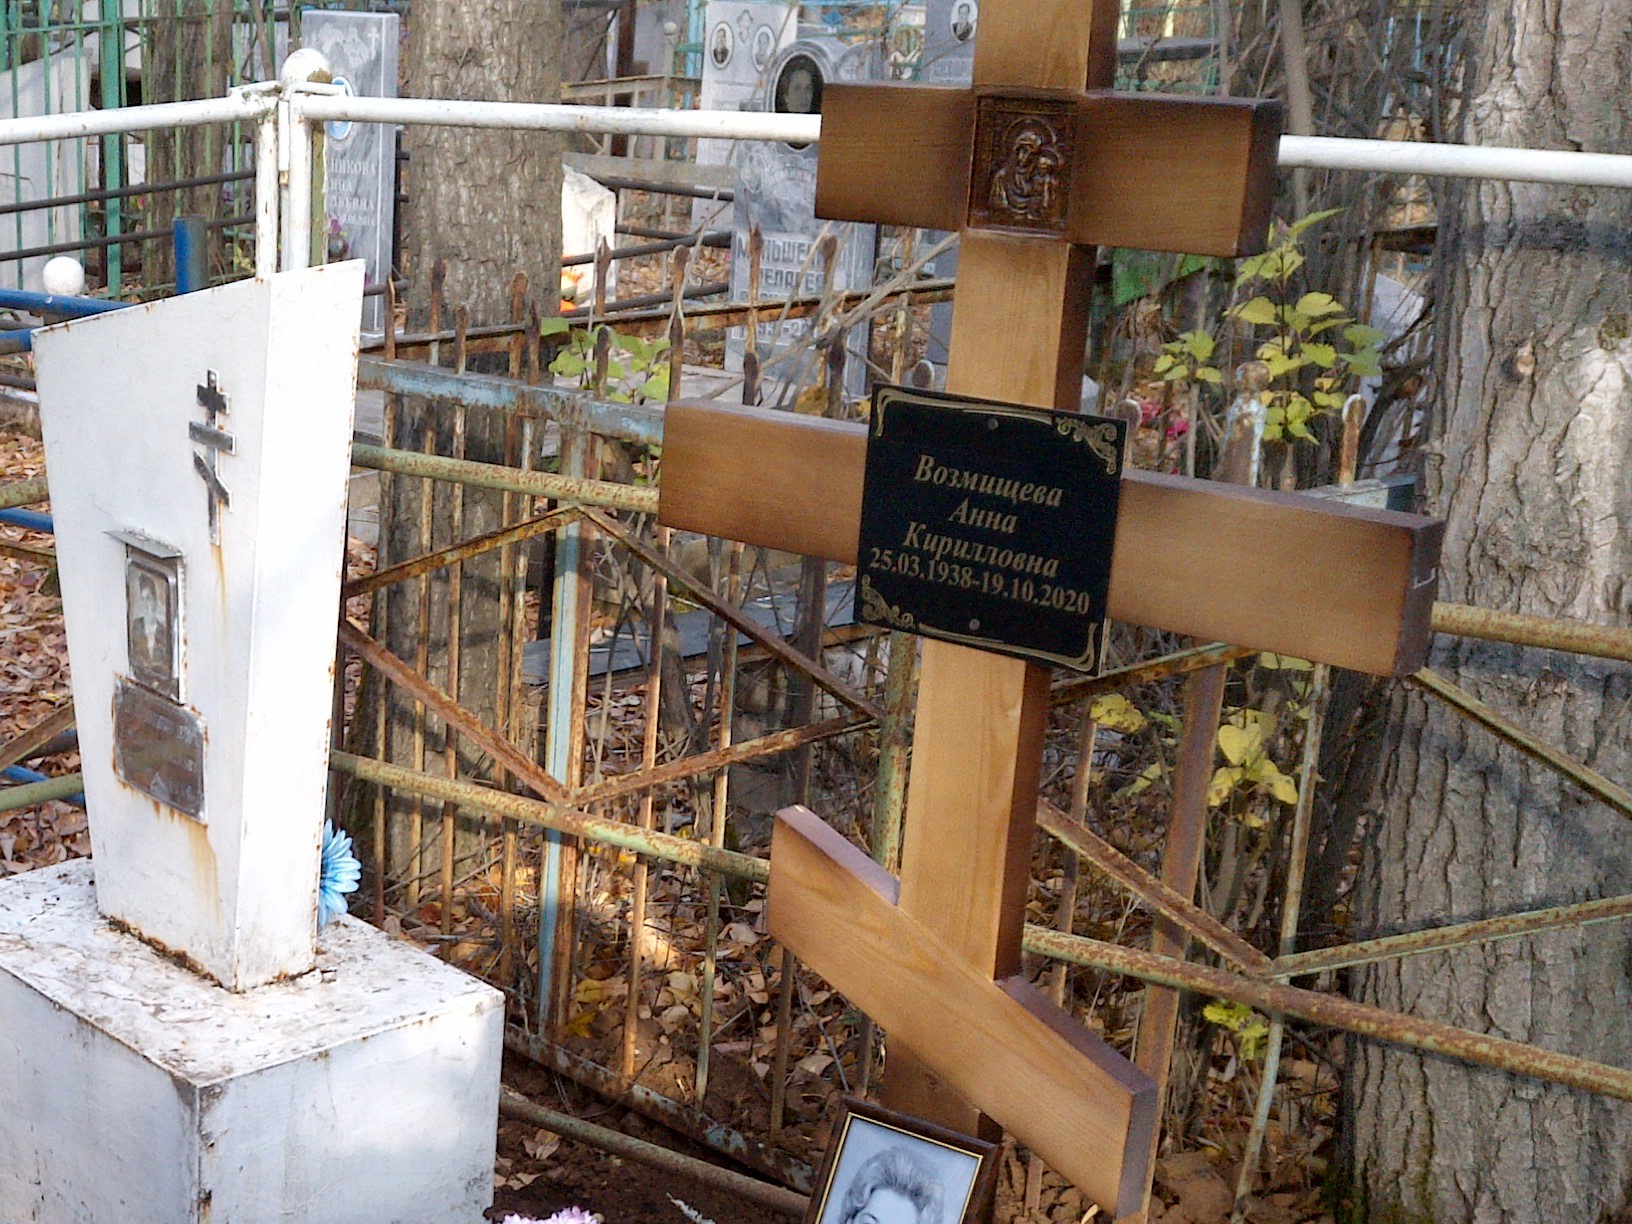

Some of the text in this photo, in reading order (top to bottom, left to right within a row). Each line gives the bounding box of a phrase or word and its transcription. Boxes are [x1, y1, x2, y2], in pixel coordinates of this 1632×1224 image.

[915, 454, 1064, 508] Возмищева
[949, 498, 1018, 534] Анна
[903, 521, 1061, 578] Кирилловна
[869, 547, 1091, 615] 25.03.1938-19.10.2020
